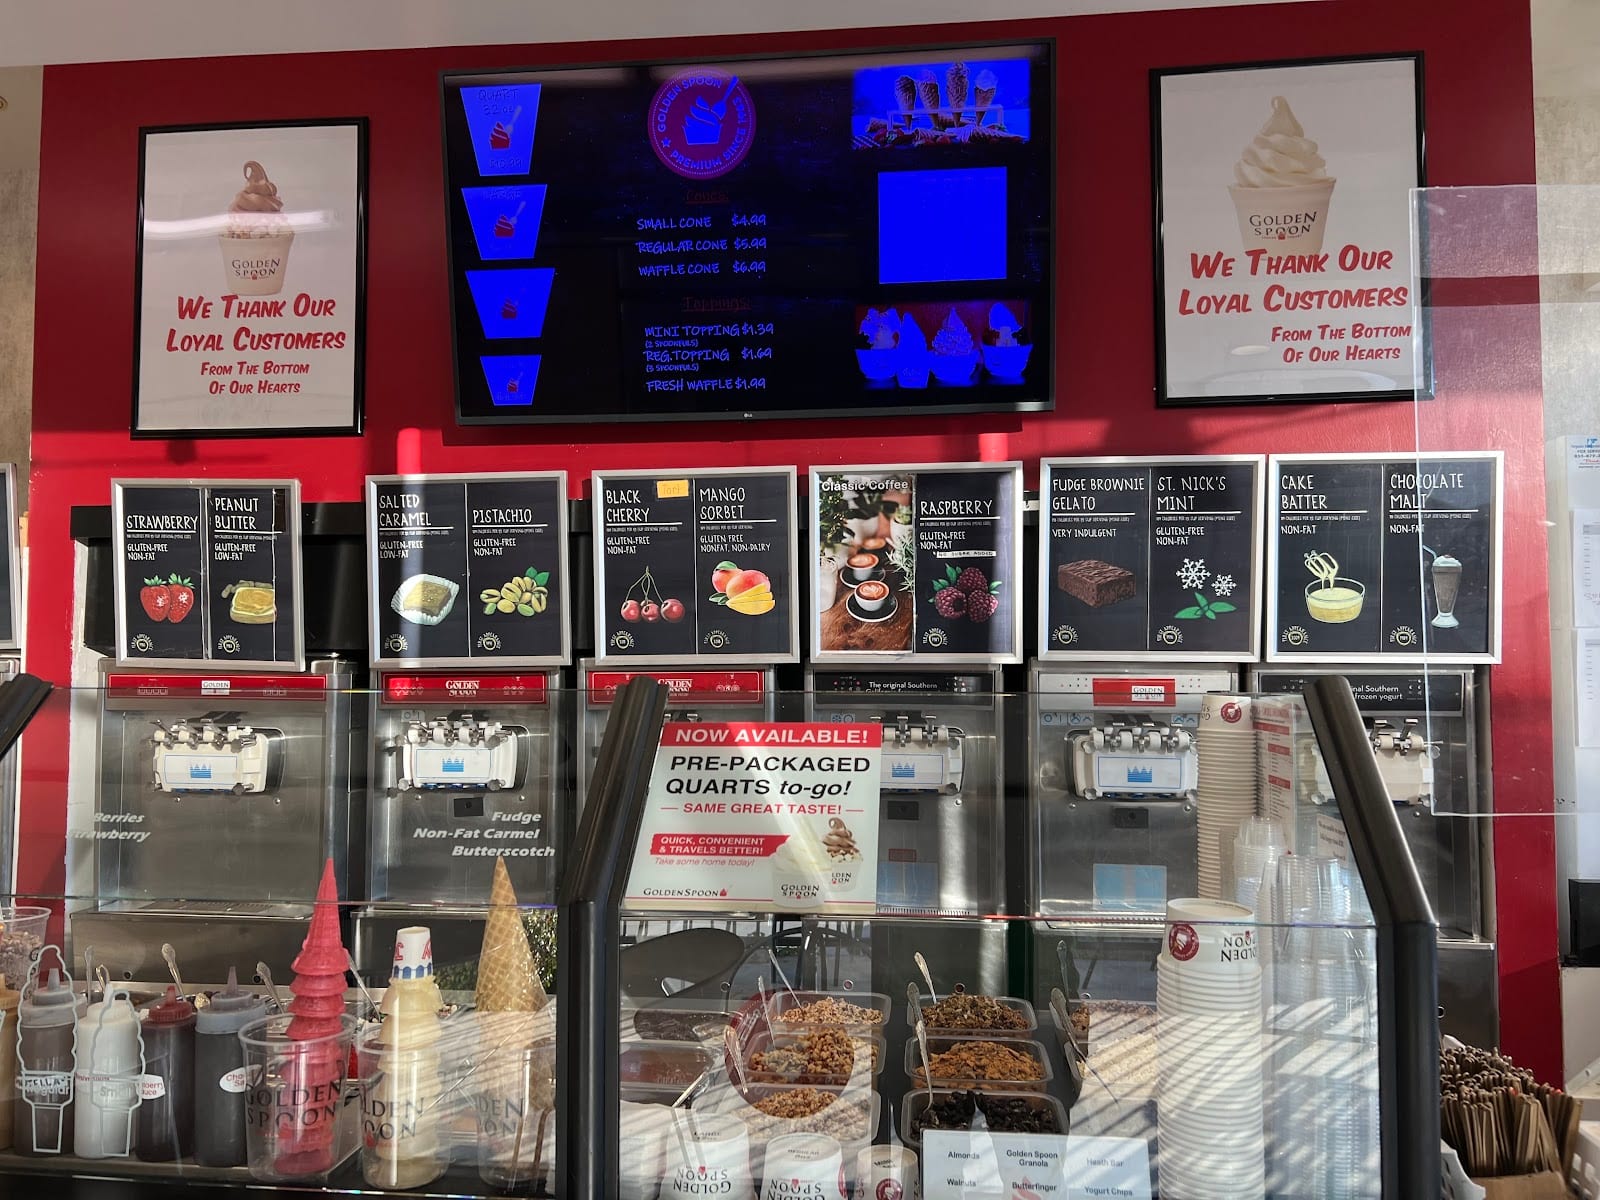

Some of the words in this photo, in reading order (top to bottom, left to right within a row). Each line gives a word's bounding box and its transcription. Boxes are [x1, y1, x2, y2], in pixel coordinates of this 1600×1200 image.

[657, 86, 682, 132] GOLDEN
[681, 76, 722, 89] SPOON
[670, 150, 722, 170] PREMIUM
[722, 128, 746, 161] SINCE
[636, 218, 677, 230] SMALL
[679, 216, 712, 228] CONE
[731, 214, 766, 228] $4.99
[1249, 211, 1318, 226] GOLDEN
[1254, 224, 1312, 238] SPOON
[635, 240, 694, 254] REGULAR
[696, 239, 728, 250] CONE
[734, 237, 767, 250] $5.99
[231, 258, 280, 272] GOLDEN
[638, 264, 686, 277] WAFFLE
[687, 263, 720, 275] CONE
[732, 260, 766, 274] $6.99
[1190, 252, 1235, 279] WE
[1245, 249, 1329, 276] THANK
[1338, 244, 1393, 272] OUR
[234, 268, 276, 278] SPOON
[177, 296, 213, 320] WE
[221, 294, 286, 318] THANK
[293, 293, 336, 317] OUR
[1178, 289, 1252, 316] LOYAL
[1262, 284, 1408, 312] CUSTOMERS
[644, 326, 680, 337] MINI
[682, 324, 740, 336] TOPPING
[1270, 326, 1312, 342] FROM
[1317, 324, 1346, 340] THE
[1352, 323, 1412, 339] BOTTOM
[166, 328, 224, 352] LOYAL
[232, 326, 346, 350] CUSTOMERS
[741, 347, 772, 360] $1.69
[1282, 348, 1304, 363] OF
[1308, 347, 1340, 362] OUR
[1345, 346, 1401, 361] HEARTS
[200, 362, 233, 376] FROM
[236, 361, 259, 374] THE
[262, 360, 310, 374] BOTTOM
[209, 381, 226, 395] OF
[229, 381, 253, 395] OUR
[257, 380, 301, 394] HEARTS
[646, 378, 684, 392] FRESH
[686, 378, 734, 391] WAFFLE
[734, 376, 766, 390] $1.99
[821, 478, 866, 492] Classic
[868, 479, 908, 490] Coffee
[1052, 478, 1086, 492] FUDGE
[1090, 477, 1145, 491] BROWNIE
[1157, 476, 1176, 492] ST.
[1181, 476, 1226, 491] NICK'S
[1281, 474, 1314, 490] CAKE
[1390, 473, 1464, 490] CHOCOLATE
[378, 494, 420, 509] SALTED
[606, 489, 642, 504] BLACK
[700, 488, 746, 502] MANGO
[1281, 494, 1328, 510] BATTER
[1390, 494, 1427, 510] MALT
[214, 497, 259, 512] PEANUT
[920, 500, 993, 516] RASPBERRY
[1052, 496, 1096, 511] GELATO
[1157, 496, 1196, 511] MINT
[378, 512, 432, 527] CARAMEL
[472, 508, 532, 524] PISTACHIO
[606, 508, 650, 523] CHERRY
[700, 505, 744, 520] SORBET
[126, 515, 199, 531] STRAWBERRY
[214, 515, 256, 530] BUTTER
[920, 531, 966, 540] GLUTEN-FREE
[1052, 529, 1072, 538] VERY
[1074, 528, 1116, 538] INDULGENT
[1156, 526, 1205, 536] GLUTEN-FREE
[1281, 525, 1316, 535] NON-FAT
[380, 540, 424, 550] GLUTEN-FREE
[473, 538, 516, 547] GLUTEN-FREE
[606, 536, 650, 545] GLUTEN-FREE
[700, 534, 726, 544] GLUTEN
[728, 534, 744, 543] FREE
[920, 540, 953, 550] NON-FAT
[1156, 536, 1190, 546] NON-FAT
[127, 543, 168, 552] GLUTEN-FREE
[214, 542, 256, 552] GLUTEN-FREE
[474, 548, 504, 556] NON-FAT
[607, 546, 637, 554] NON-FAT
[700, 543, 730, 553] NONFAT,
[731, 543, 771, 552] NON-DAIRY
[127, 552, 156, 561] NON-FAT
[214, 552, 243, 561] LOW-FAT
[380, 550, 410, 559] LOW-FAT
[446, 680, 480, 690] GOLDEN
[883, 682, 906, 690] original
[1380, 694, 1402, 702] yogurt
[675, 729, 730, 743] NOW
[734, 729, 868, 744] AVAILABLE!
[670, 756, 870, 772] PRE-PACKAGED
[666, 779, 770, 796] QUARTS
[780, 780, 852, 799] to-go!
[683, 803, 726, 814] SAME
[730, 804, 784, 814] GREAT
[788, 804, 842, 815] TASTE!
[94, 812, 145, 824] Berries
[492, 812, 542, 824] Fudge
[414, 828, 480, 839] Non-Fat
[484, 828, 540, 839] Carmel
[660, 837, 695, 846] QUICK,
[698, 838, 765, 846] CONVENIENT
[452, 846, 556, 857] Butterscotch
[658, 846, 666, 854] &
[669, 846, 717, 854] TRAVELS
[720, 846, 764, 855] BETTER!
[655, 858, 674, 866] Take
[702, 858, 726, 866] home
[728, 858, 755, 868] today!
[781, 884, 820, 892] GOLDEN
[782, 889, 818, 898] SPOON
[948, 1152, 980, 1160] Almonds
[1006, 1150, 1032, 1159] Golden
[1034, 1151, 1058, 1160] Spoon
[1019, 1159, 1049, 1168] Granola
[677, 1168, 728, 1182] SPOON
[673, 1180, 732, 1194] GOLDEN
[770, 1178, 822, 1194] SPOON
[946, 1178, 976, 1188] Walnuts
[1012, 1182, 1058, 1192] Butterfinger
[1084, 1186, 1110, 1196] Yogurt
[1112, 1188, 1133, 1197] Chips
